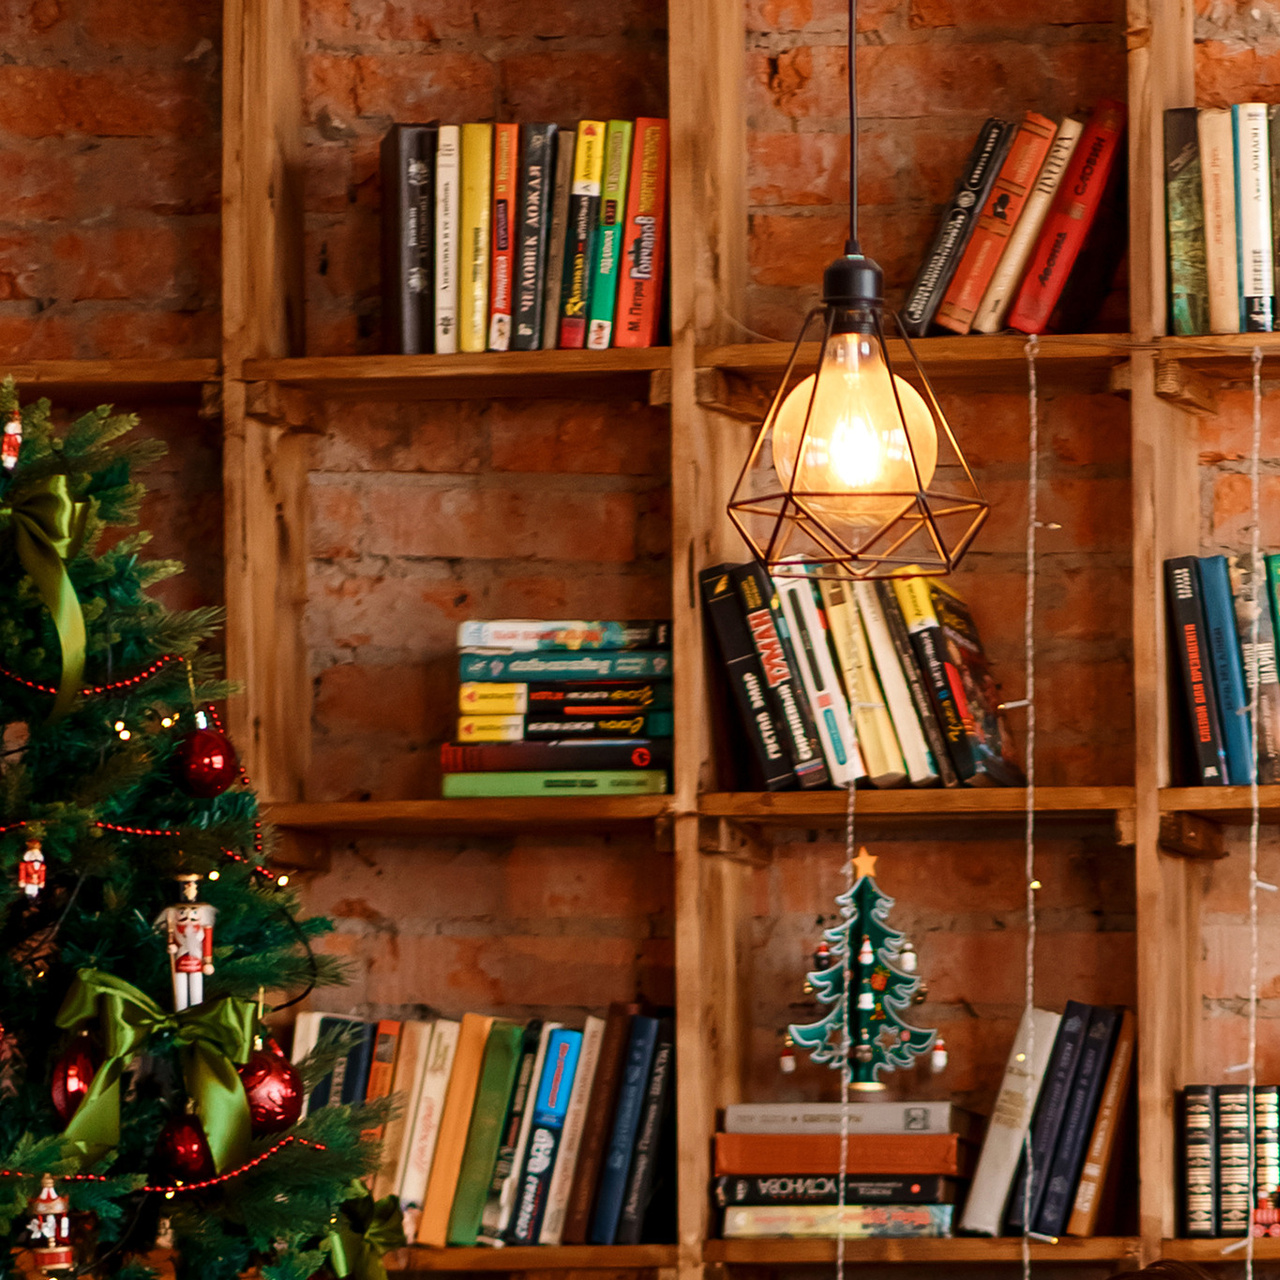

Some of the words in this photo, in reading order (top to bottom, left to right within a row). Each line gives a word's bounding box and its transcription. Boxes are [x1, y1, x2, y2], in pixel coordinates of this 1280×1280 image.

[1074, 136, 1105, 196] СЛОВИН
[520, 235, 538, 312] ЧЕЛОВЕК
[629, 215, 656, 278] Гончаров
[628, 281, 644, 316] Петров
[747, 608, 792, 689] ТУМАН
[1183, 623, 1203, 682] ПРЕЗИДЕНТА
[742, 671, 766, 710] ЭМАР
[755, 710, 782, 761] ГУСТАВ
[776, 684, 813, 762] СИРЕНЕВЫЙ
[1194, 705, 1211, 743] СЛЕПОЙ
